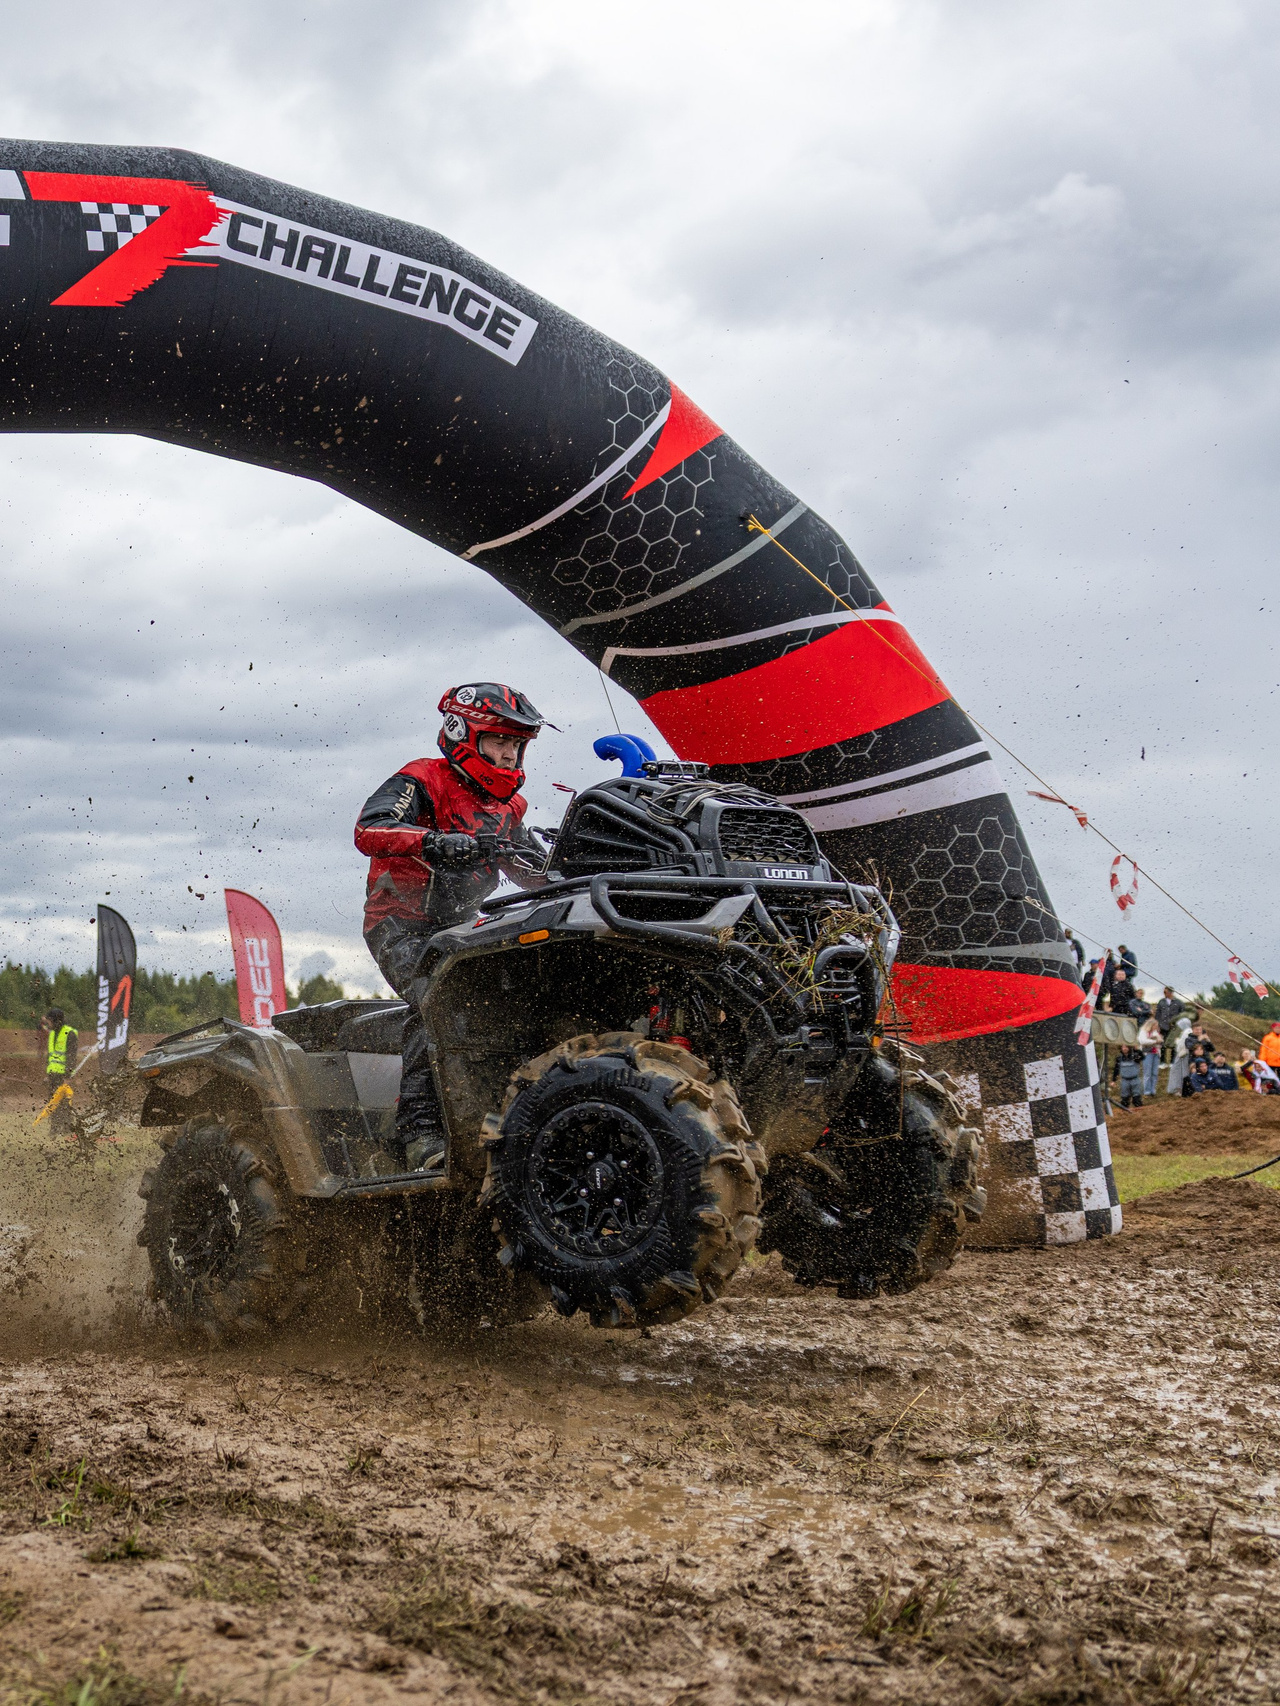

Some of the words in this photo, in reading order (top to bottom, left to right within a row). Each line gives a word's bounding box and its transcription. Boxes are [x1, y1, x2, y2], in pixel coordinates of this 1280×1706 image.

[226, 213, 521, 349] CHALLENGE
[445, 714, 459, 732] 98
[449, 705, 507, 723] SCOTT
[764, 868, 809, 880] LONCIN
